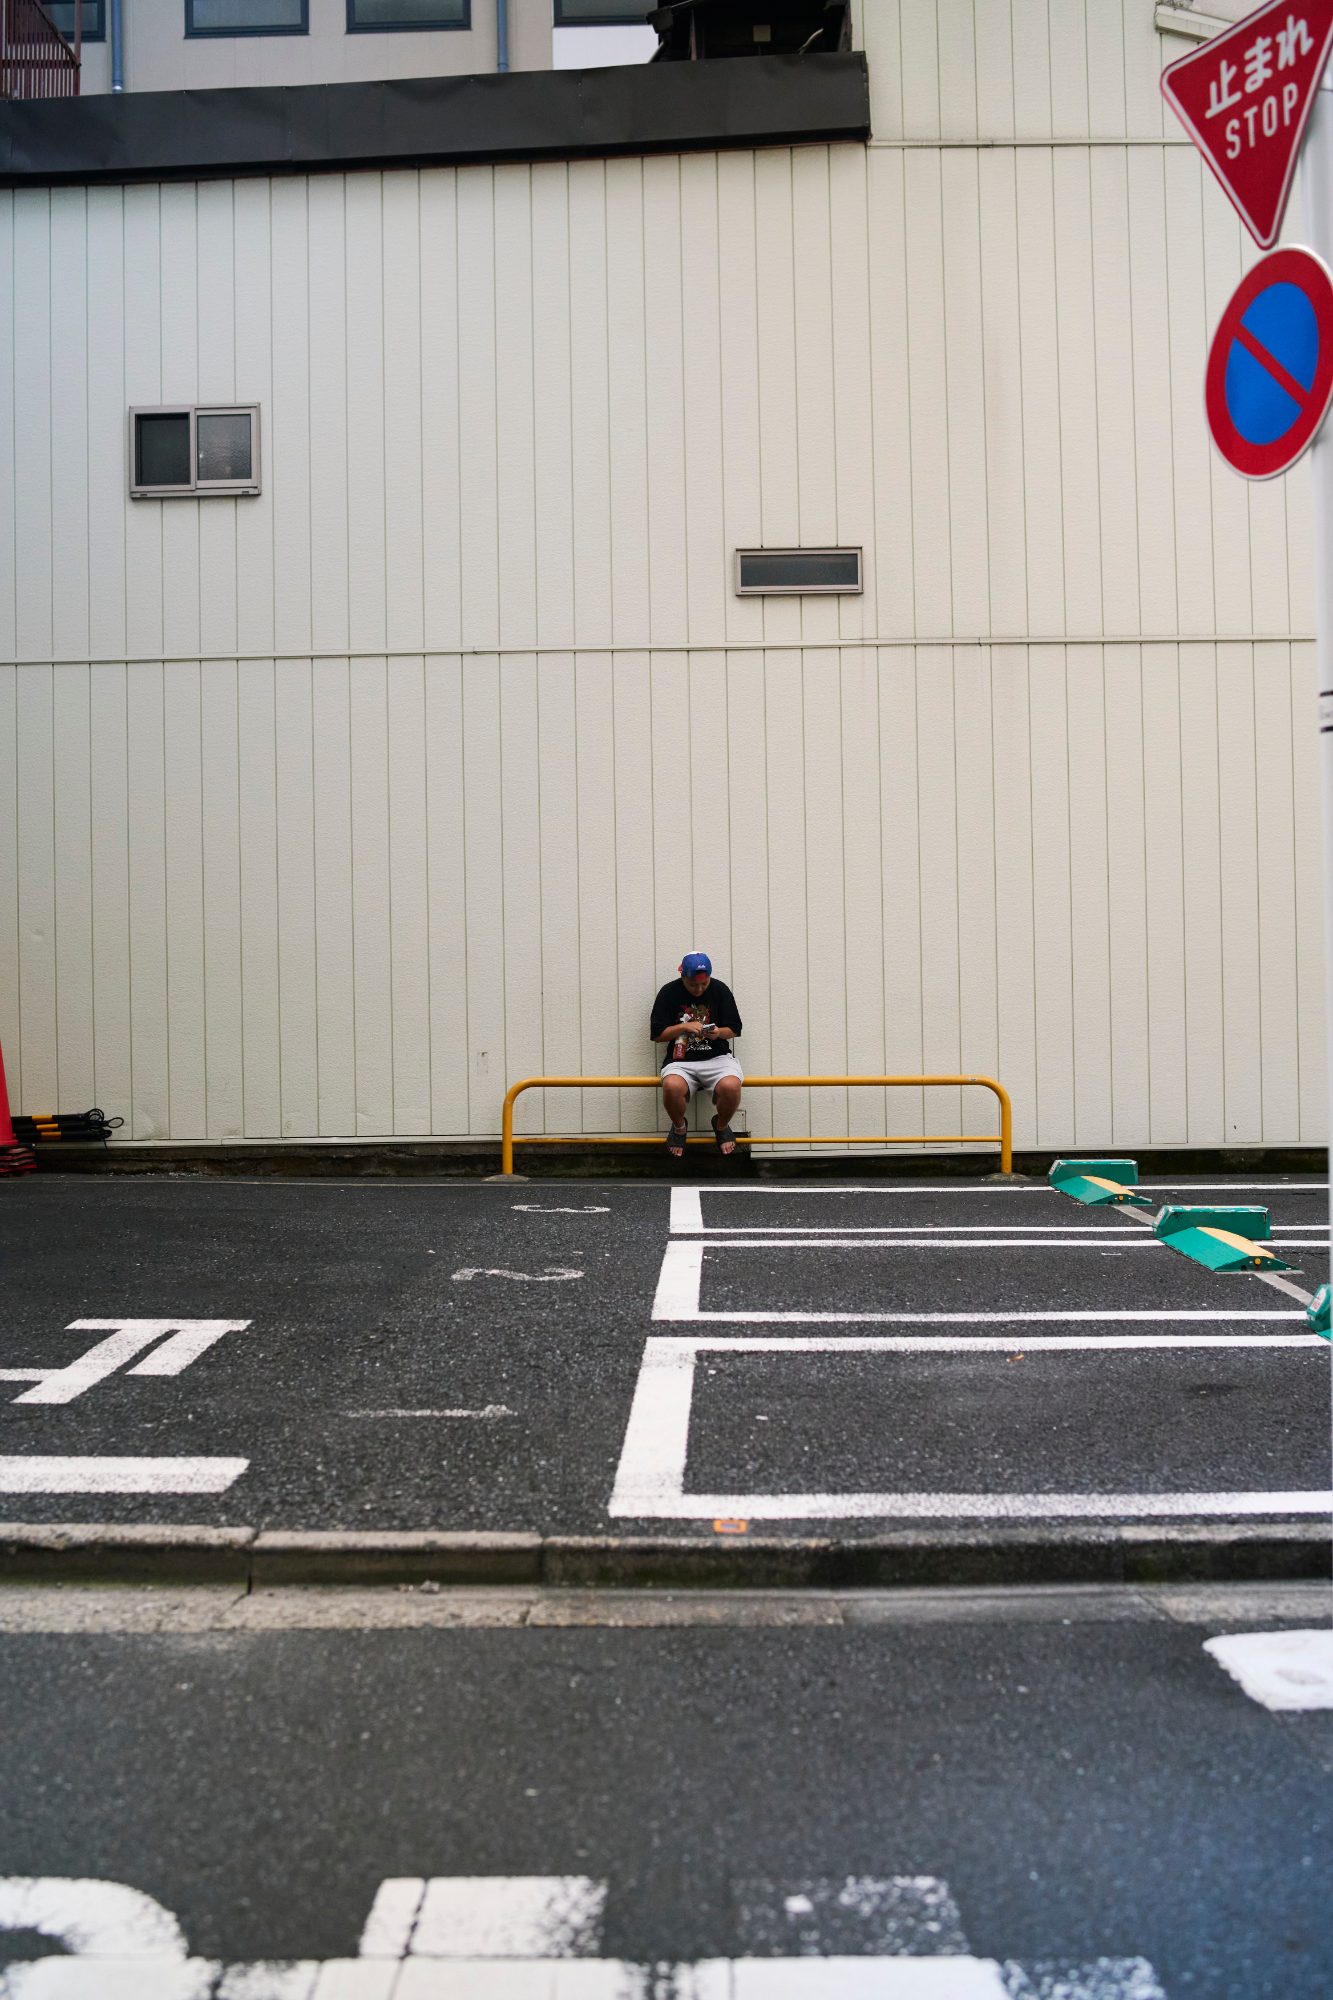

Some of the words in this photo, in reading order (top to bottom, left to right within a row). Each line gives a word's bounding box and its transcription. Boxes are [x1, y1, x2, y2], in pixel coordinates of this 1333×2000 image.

[1205, 15, 1314, 119] 止まれ
[1226, 82, 1298, 160] STOP
